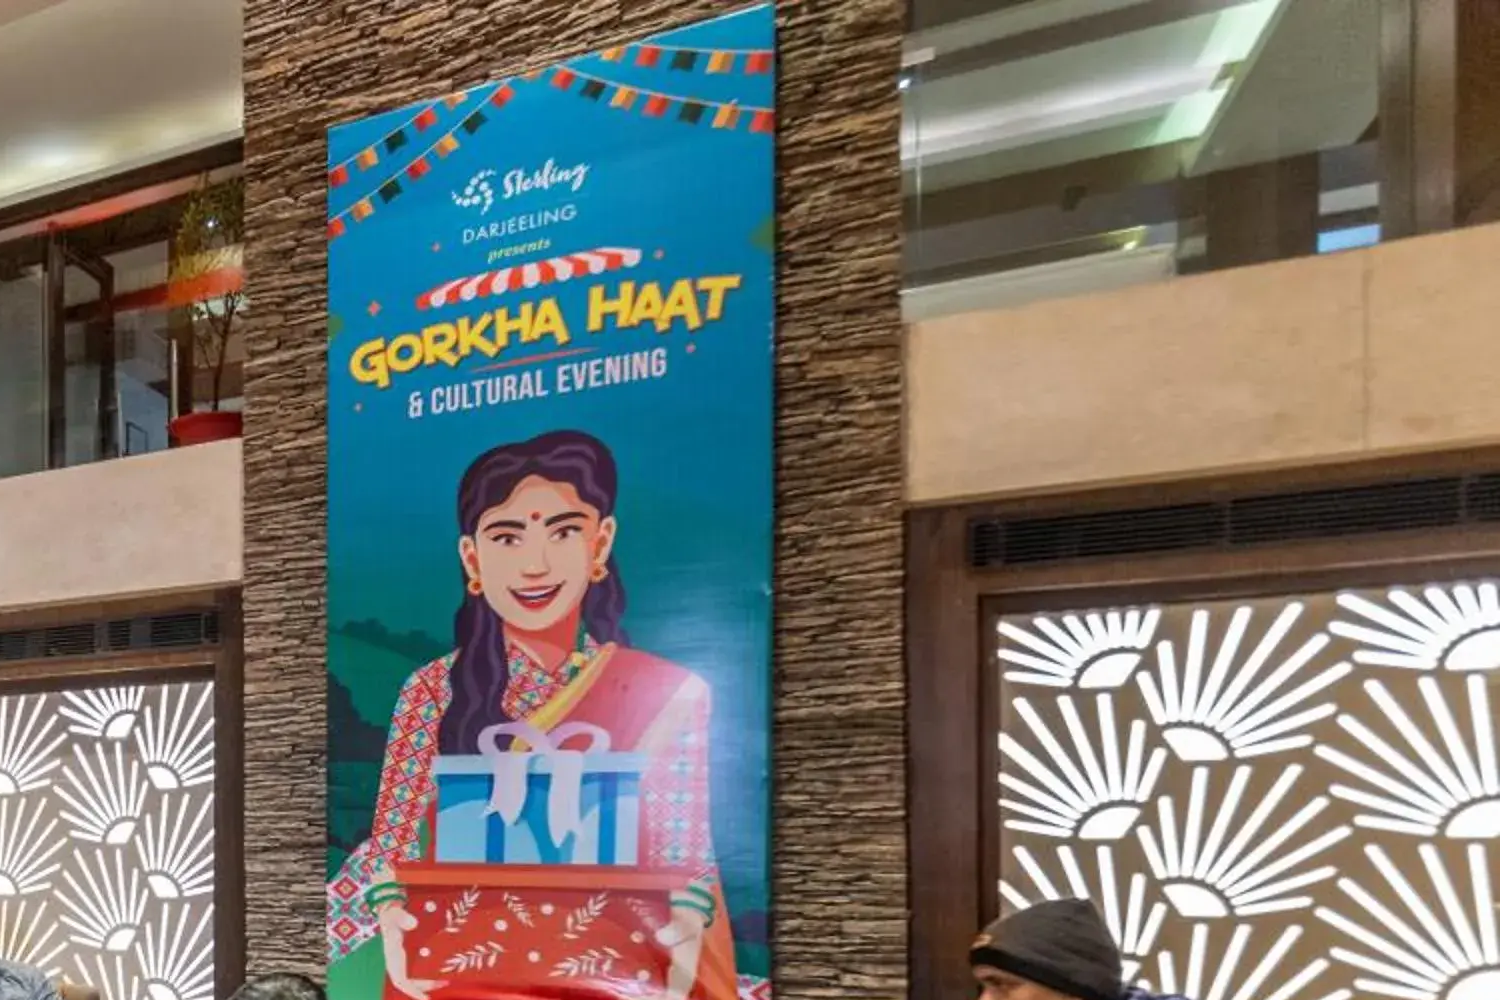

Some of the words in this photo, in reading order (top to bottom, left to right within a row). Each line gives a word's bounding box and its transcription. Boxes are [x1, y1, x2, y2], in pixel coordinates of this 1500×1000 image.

[502, 157, 591, 199] Sterling
[462, 203, 578, 245] DARJEELING
[487, 237, 552, 264] presents
[349, 297, 571, 388] GORKHA
[586, 274, 742, 333] HAAT
[407, 390, 424, 419] &
[430, 368, 550, 415] CULTURAL
[556, 347, 668, 393] EVENING
